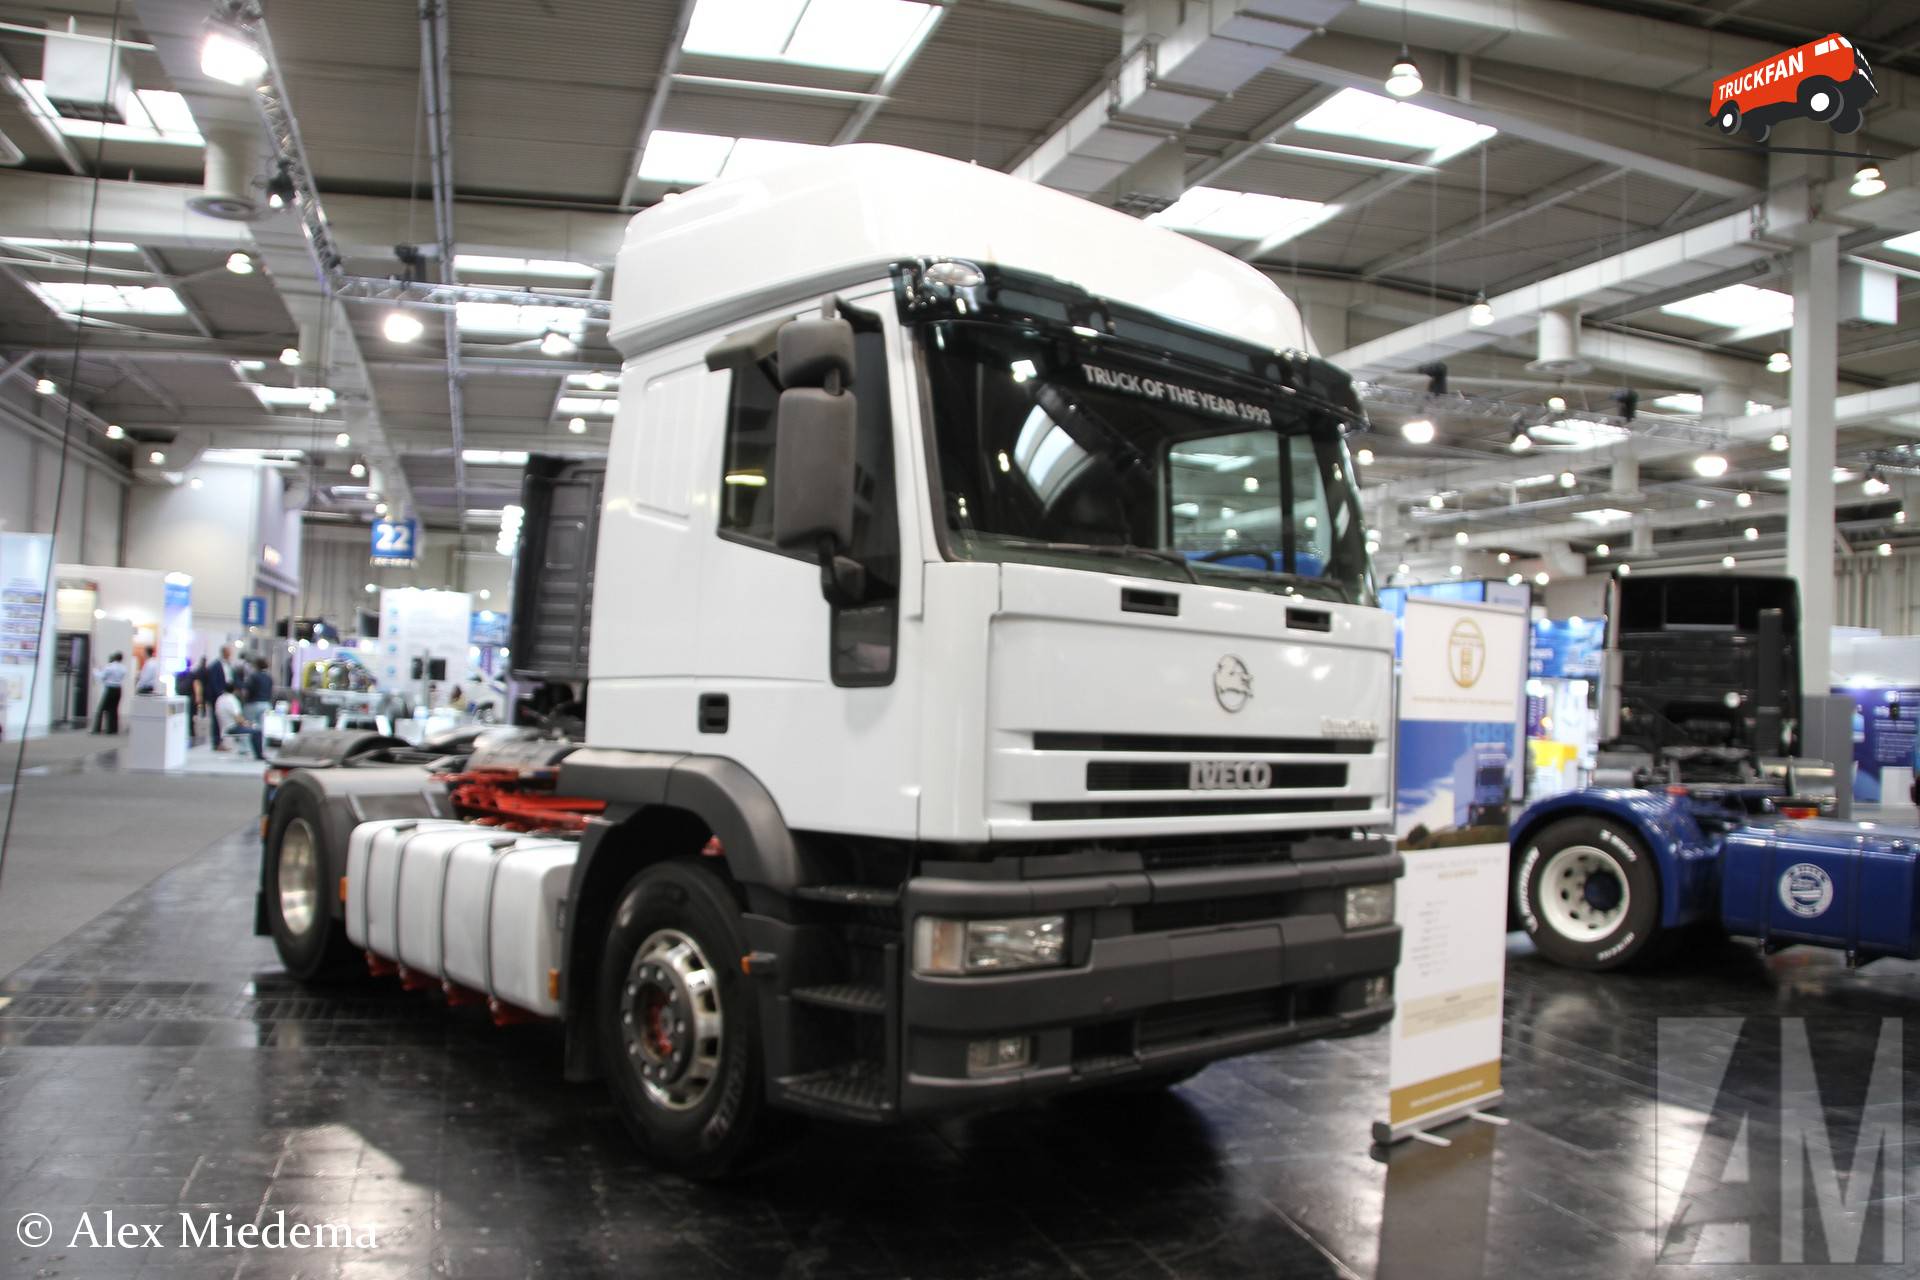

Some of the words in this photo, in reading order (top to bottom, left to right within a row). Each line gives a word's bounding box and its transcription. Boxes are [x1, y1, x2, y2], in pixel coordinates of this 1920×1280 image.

[1081, 363, 1142, 393] TRUCK
[1141, 378, 1165, 398] OF
[1166, 382, 1200, 408] THE
[1199, 391, 1238, 416] YEAR
[375, 523, 411, 551] 22
[1189, 761, 1273, 789] IVECO
